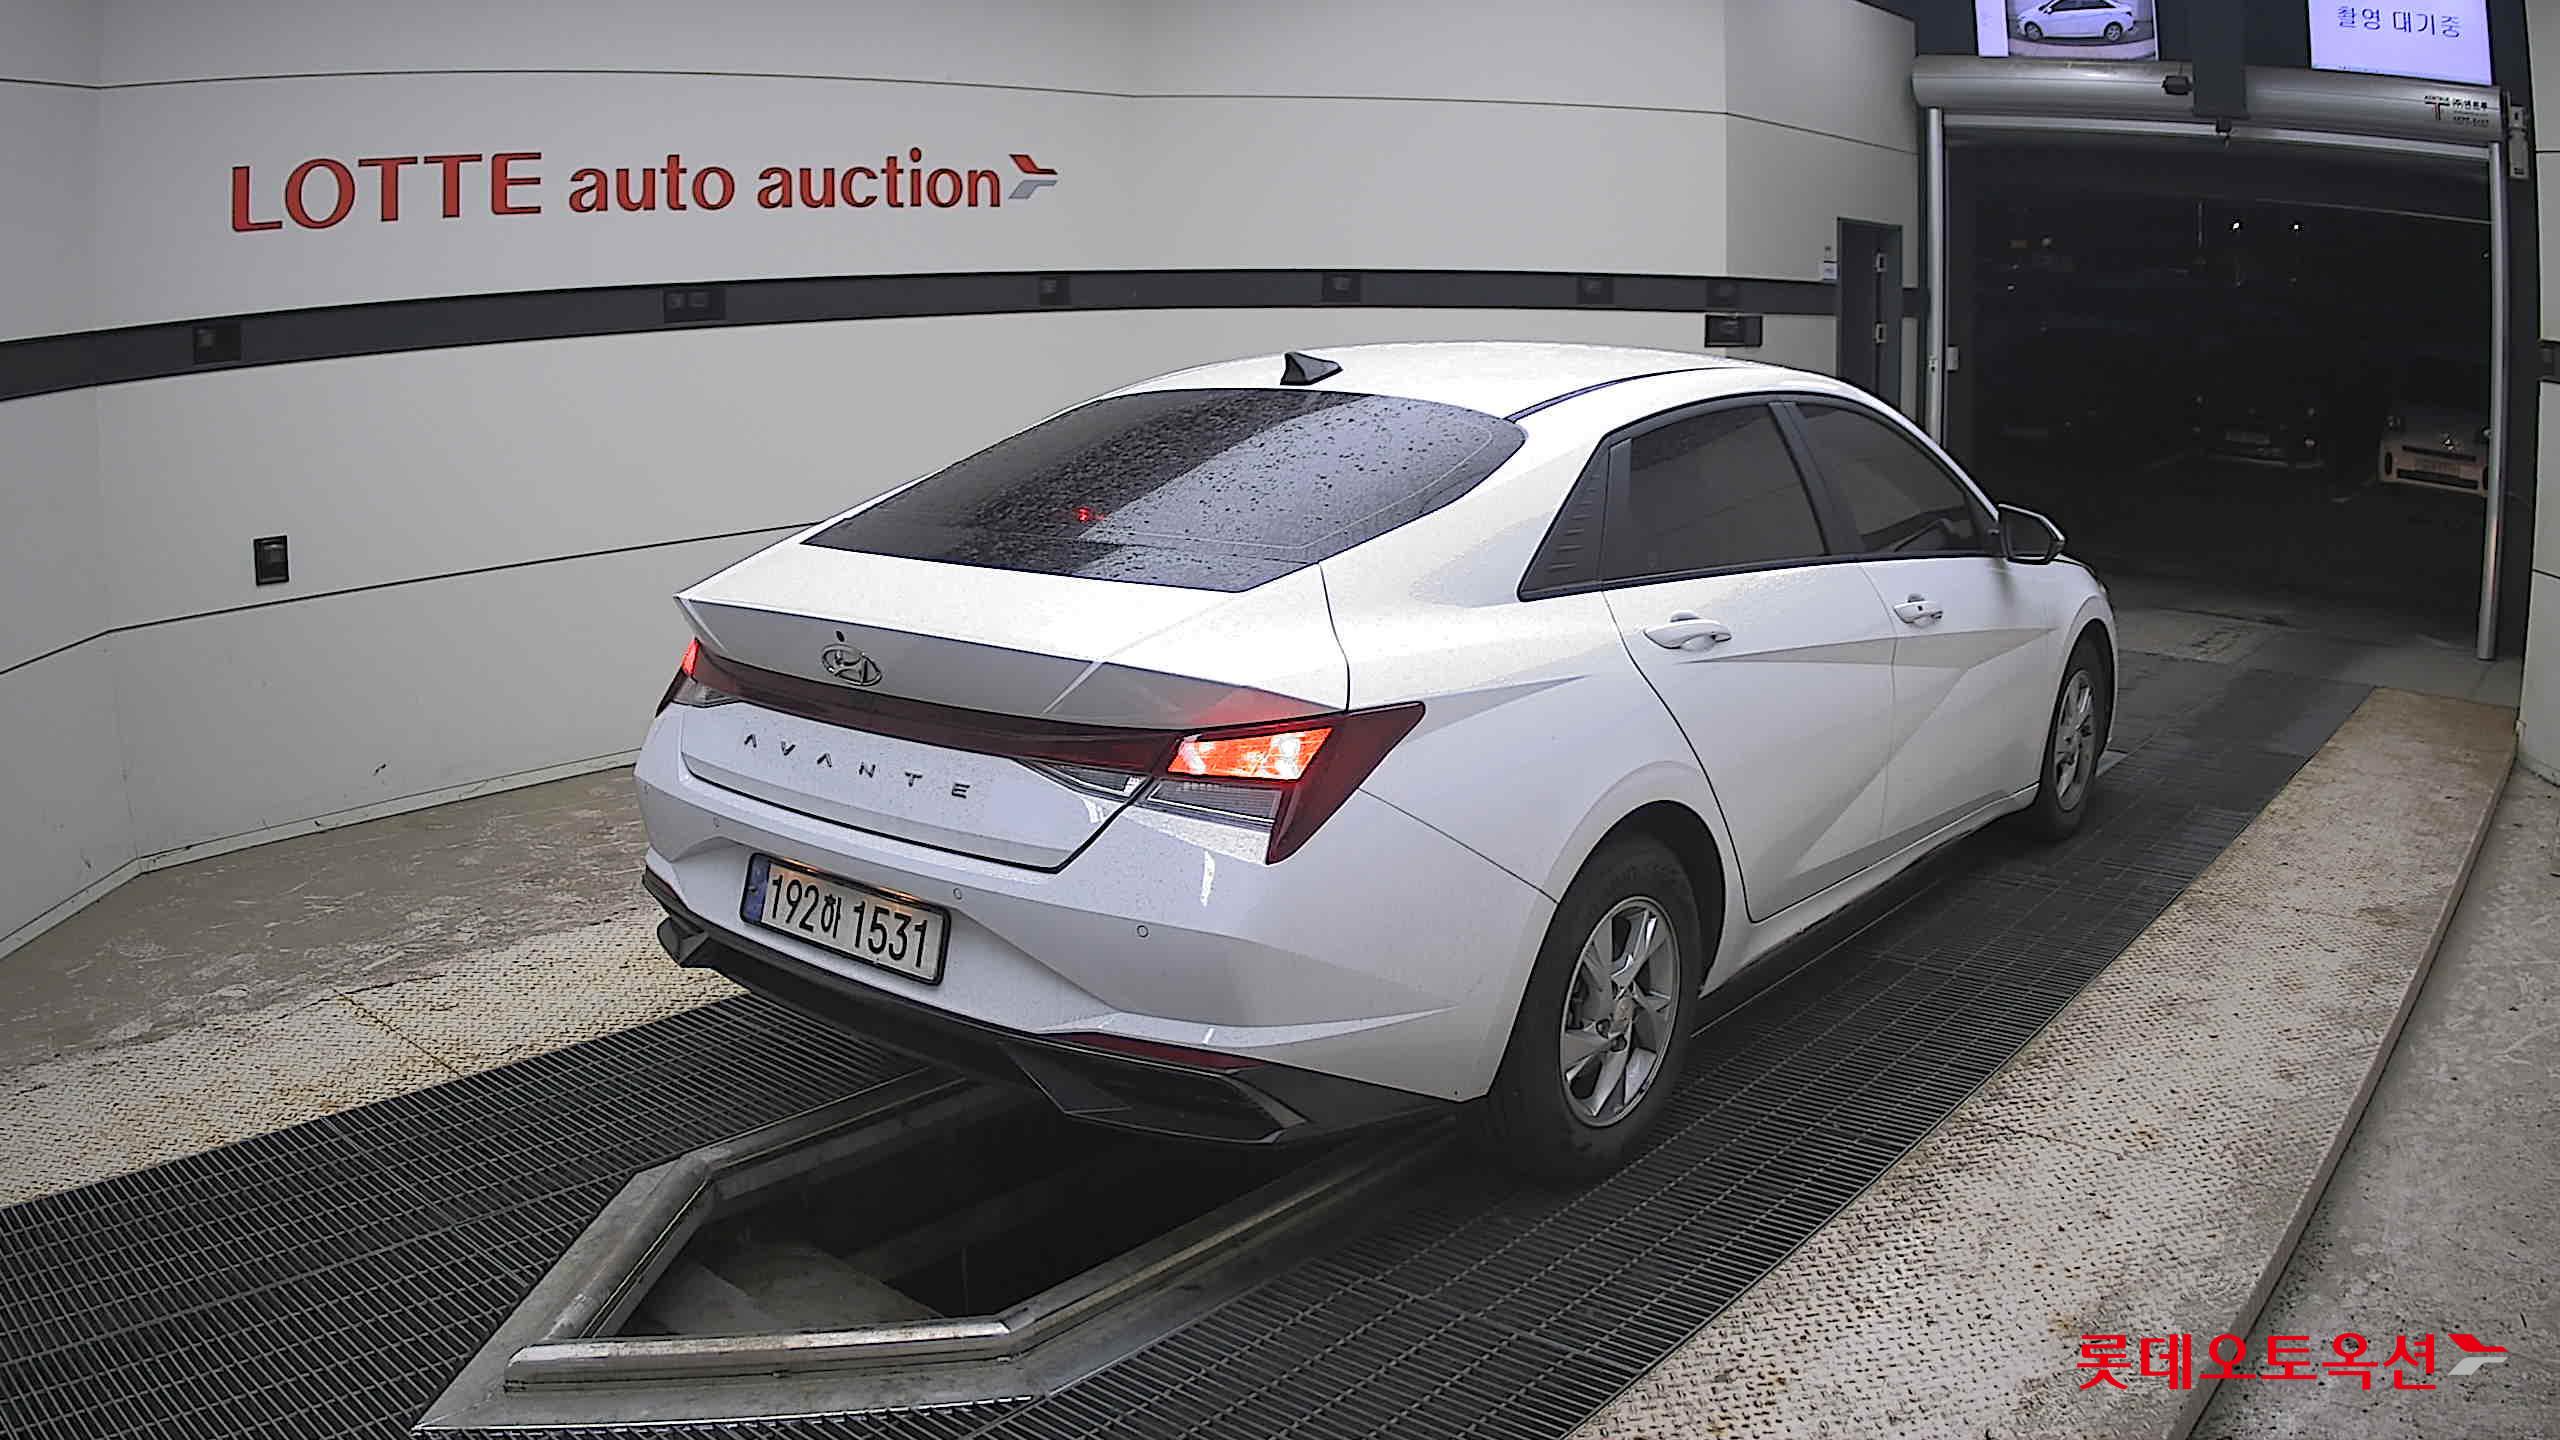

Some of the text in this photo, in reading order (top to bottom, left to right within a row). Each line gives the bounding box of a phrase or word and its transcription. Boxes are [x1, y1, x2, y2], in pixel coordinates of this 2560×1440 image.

[2392, 11, 2461, 38] 대기중
[231, 147, 1002, 234] LOTTE auto auction
[743, 733, 971, 799] AVANTE
[771, 874, 928, 969] 192하 1531
